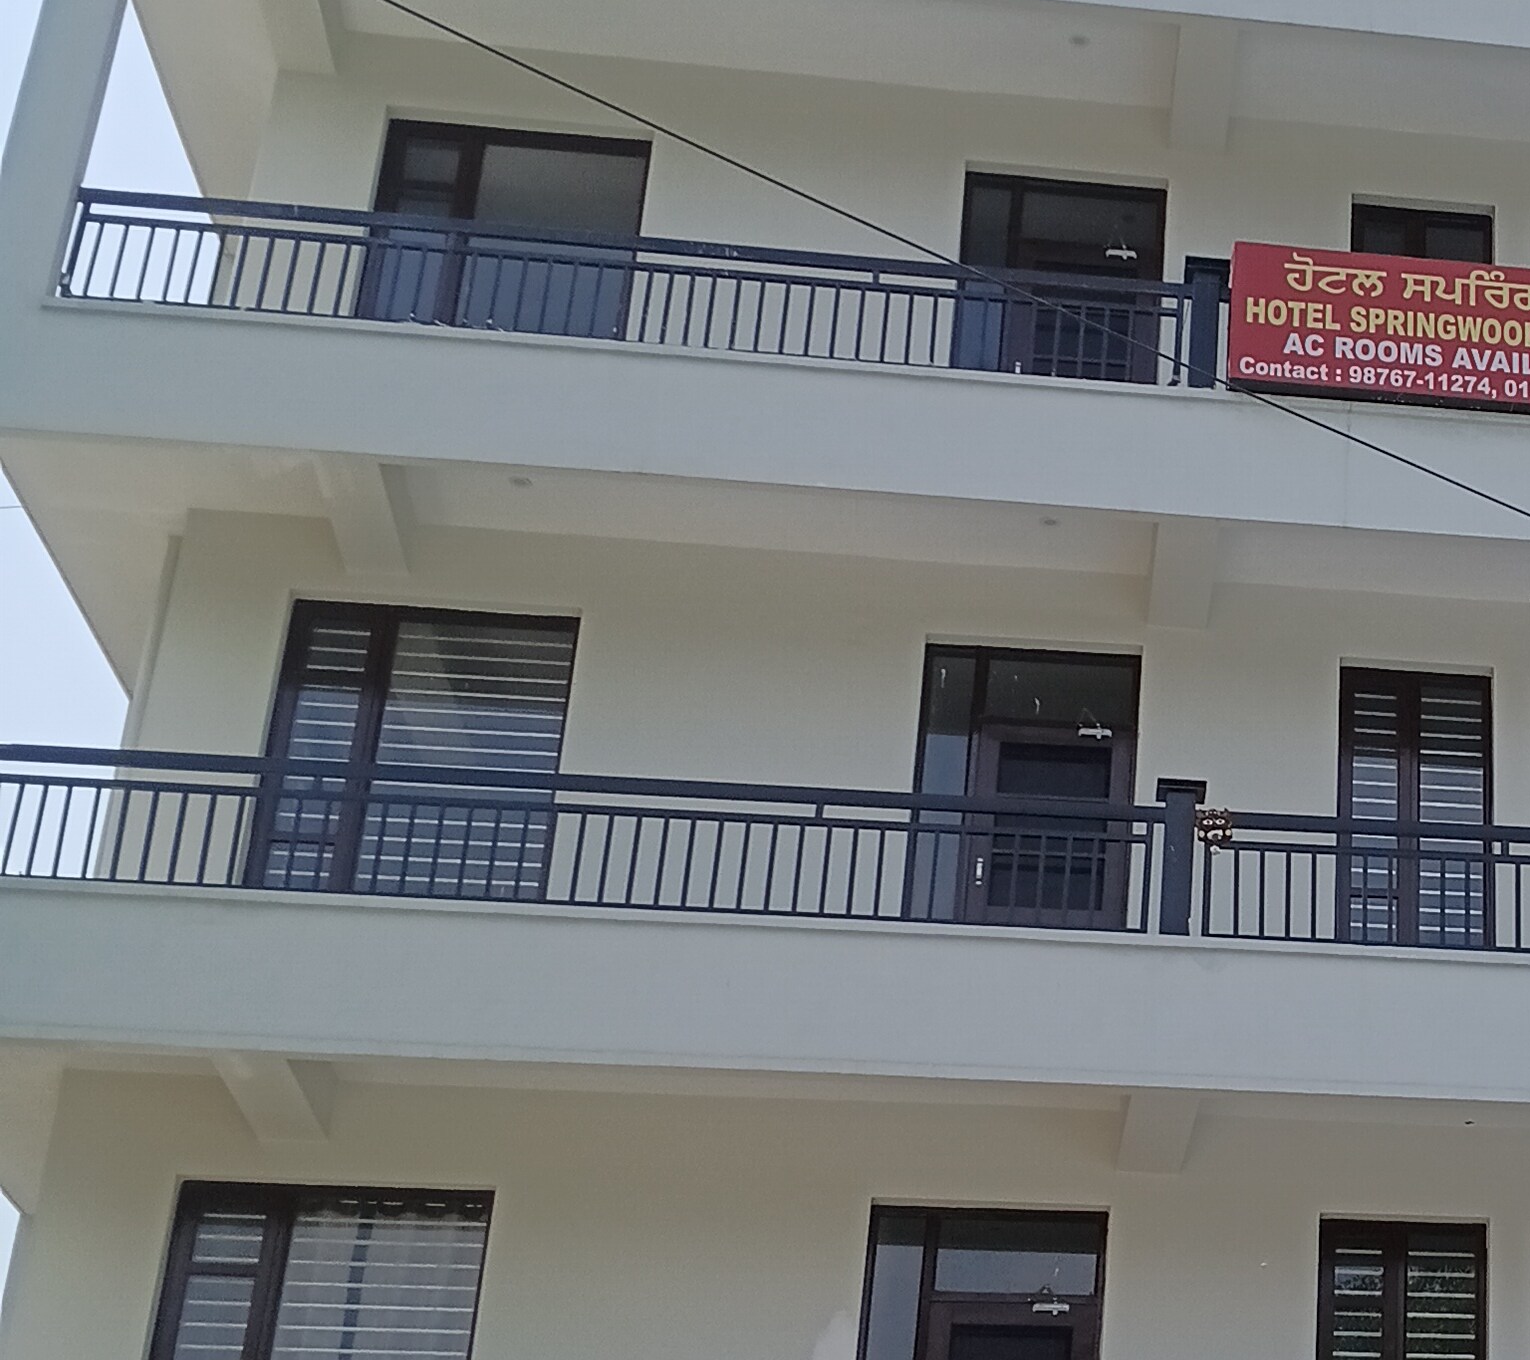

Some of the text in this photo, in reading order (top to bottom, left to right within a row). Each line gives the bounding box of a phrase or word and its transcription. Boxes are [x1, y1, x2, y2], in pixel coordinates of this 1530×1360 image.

[1284, 252, 1387, 297] ਹੋਟਲ
[1246, 297, 1341, 331] HOTEL
[1283, 332, 1325, 357] AC
[1335, 336, 1443, 367] ROOMS
[1239, 356, 1329, 381] Contact
[1335, 368, 1342, 382] :
[1349, 366, 1497, 399] 98767-11274,
